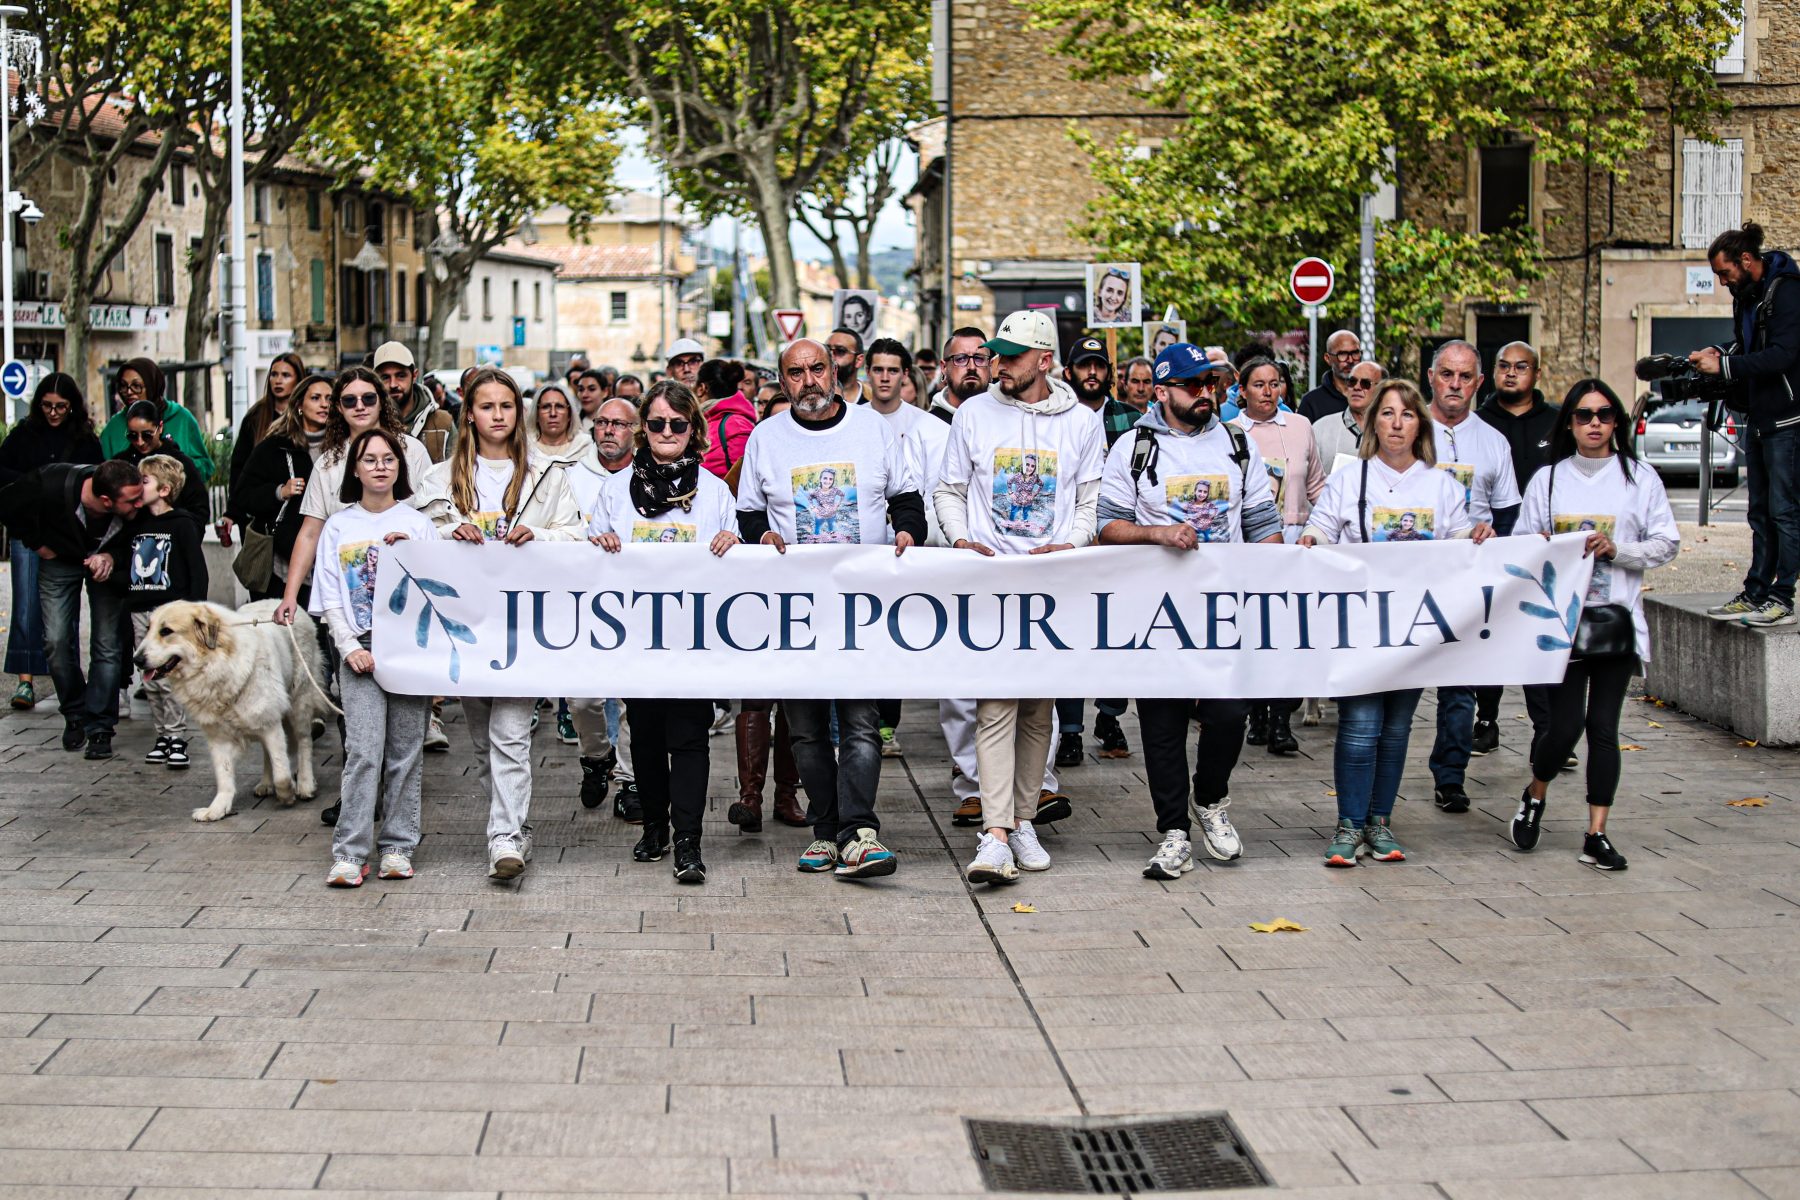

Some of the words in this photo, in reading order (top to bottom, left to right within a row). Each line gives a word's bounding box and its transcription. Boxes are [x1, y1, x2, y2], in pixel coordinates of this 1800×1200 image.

[1696, 280, 1712, 289] aps
[1186, 346, 1205, 362] LA
[490, 588, 817, 670] JUSTICE
[837, 592, 1074, 652] POUR
[1090, 588, 1461, 651] LAETITIA
[1478, 585, 1495, 640] !
